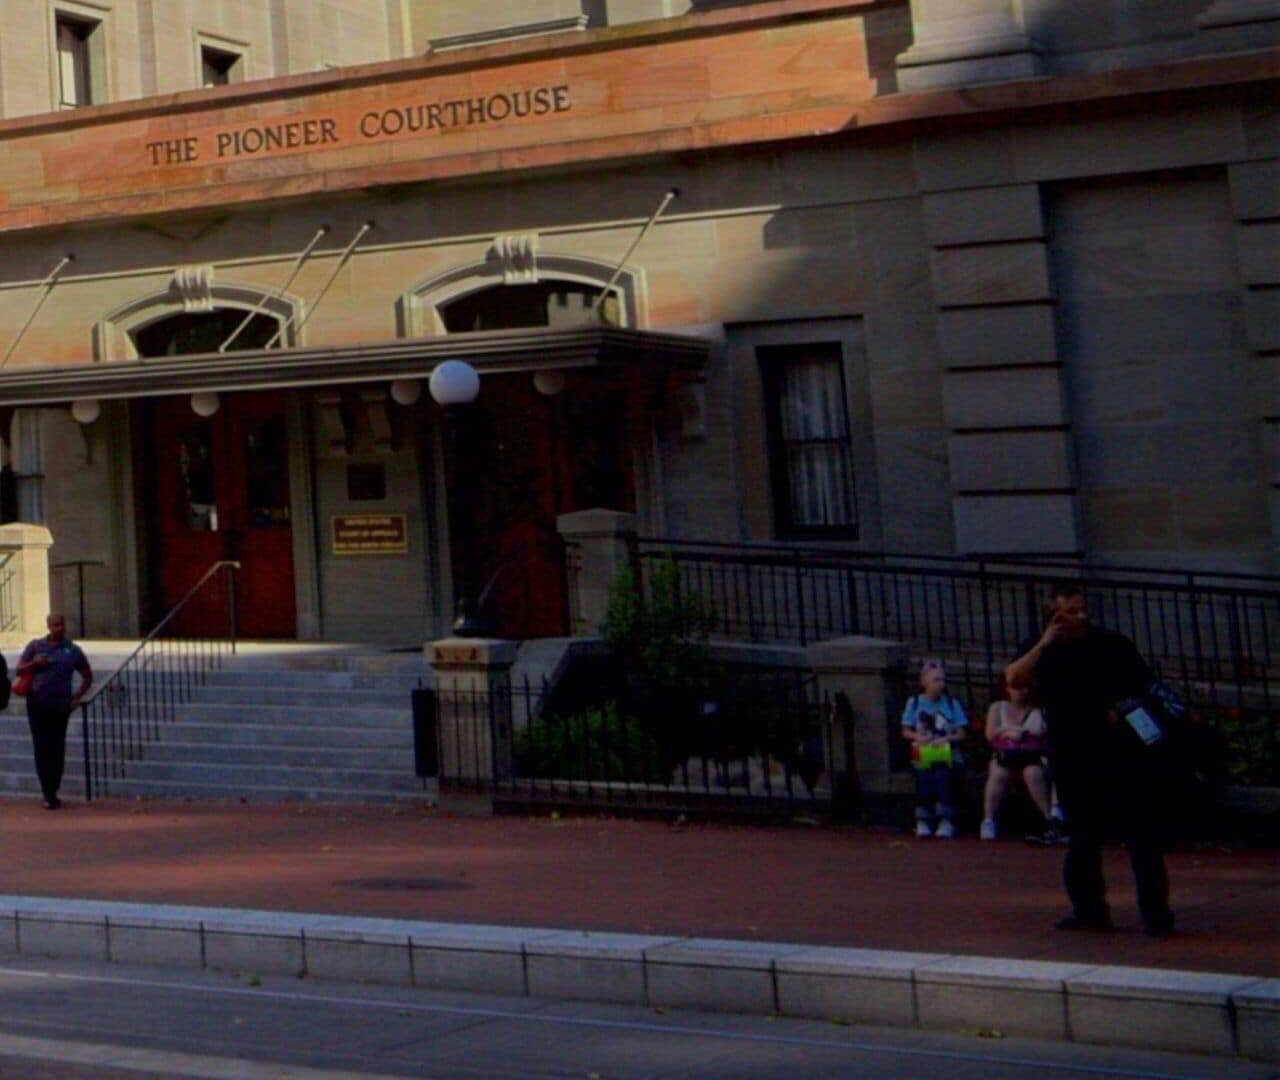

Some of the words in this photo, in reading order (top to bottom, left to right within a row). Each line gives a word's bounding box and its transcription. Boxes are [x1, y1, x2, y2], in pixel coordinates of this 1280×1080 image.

[147, 136, 199, 165] THE
[217, 118, 339, 157] PIONEER
[360, 85, 570, 139] COURTHOUSE
